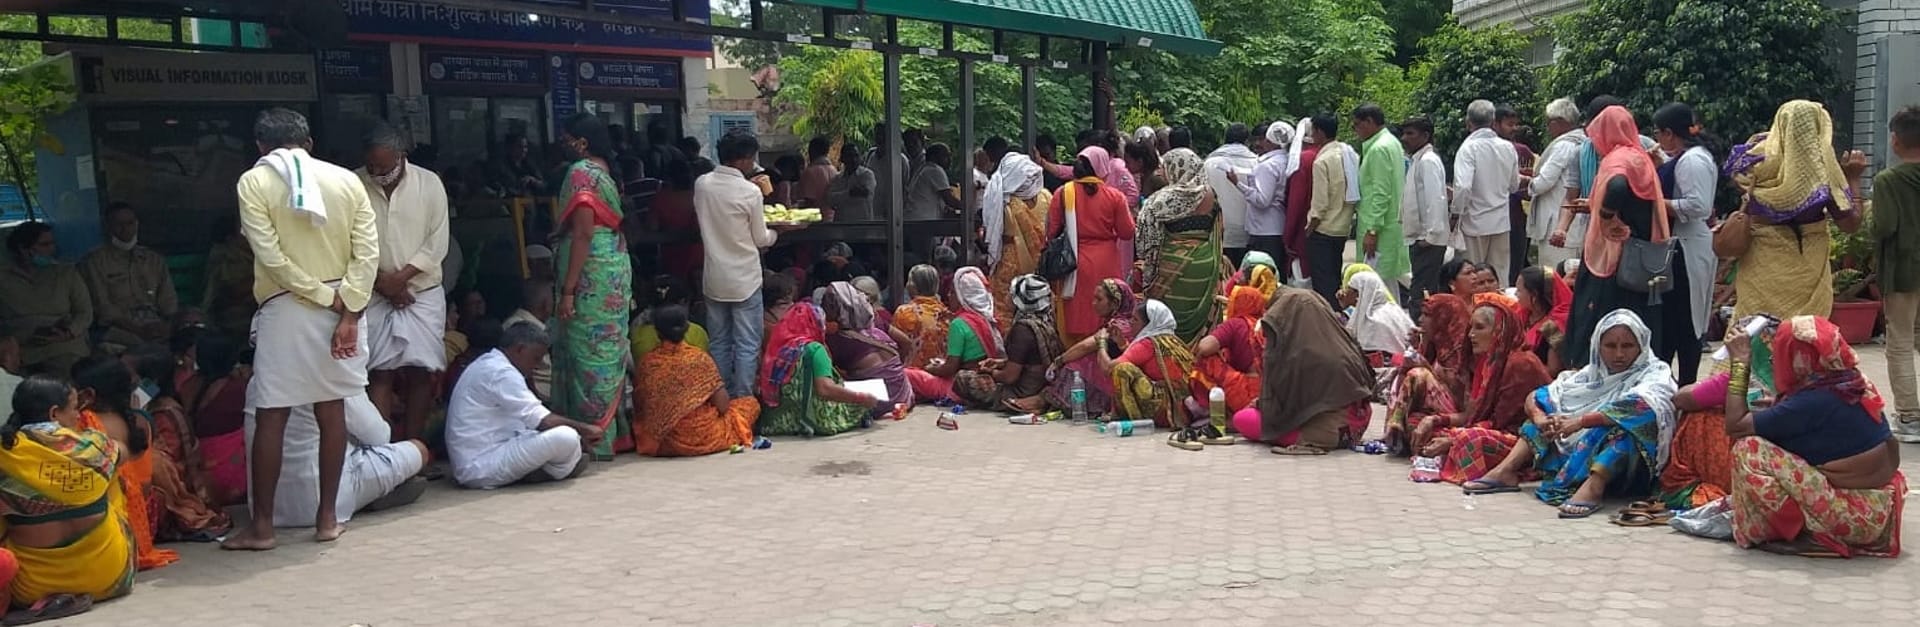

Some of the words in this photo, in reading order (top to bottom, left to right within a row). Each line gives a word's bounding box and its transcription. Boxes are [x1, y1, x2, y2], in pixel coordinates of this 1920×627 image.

[111, 68, 163, 84] VISUAL
[168, 69, 263, 86] INFORMATION
[267, 70, 308, 86] KIOSK
